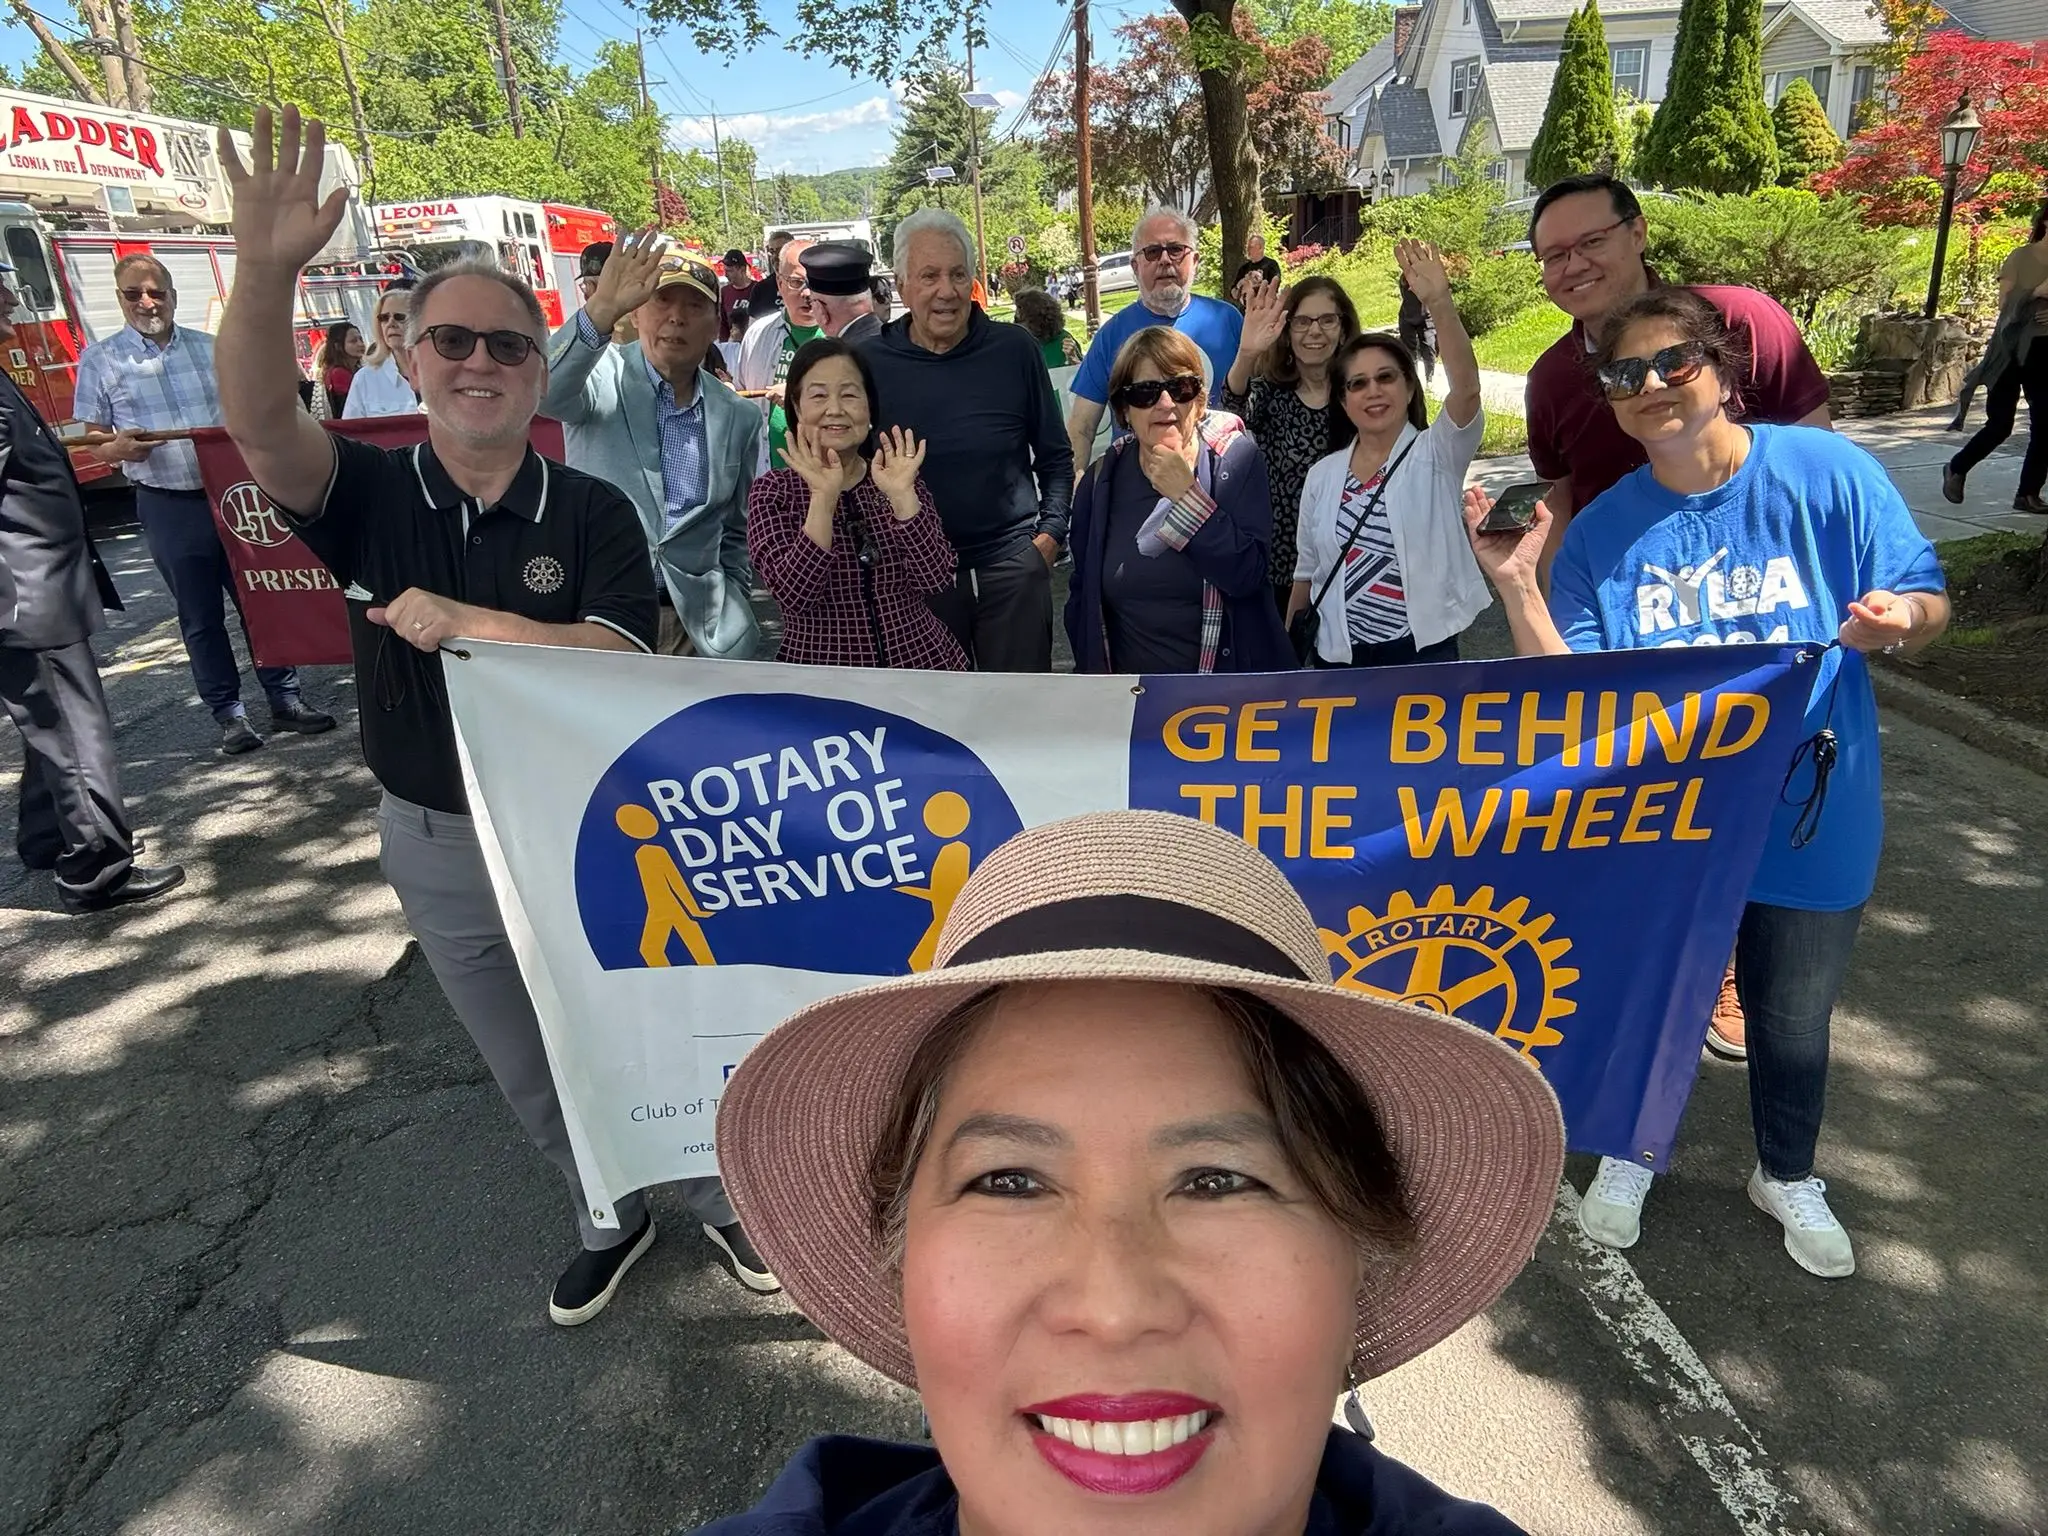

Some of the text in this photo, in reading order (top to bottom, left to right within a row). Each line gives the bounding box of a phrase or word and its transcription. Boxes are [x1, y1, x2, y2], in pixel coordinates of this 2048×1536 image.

[0, 105, 164, 178] ADDER
[8, 154, 147, 181] LEONIA FIRE DEPARTMENT
[380, 203, 459, 221] LEONIA
[1636, 547, 1810, 635] RYLA
[1162, 691, 1771, 767] GET BEHIND
[647, 727, 886, 822] ROTARY
[670, 778, 907, 868] DAY OF
[1179, 777, 1713, 859] THE WHEEL
[692, 834, 925, 911] SERVICE
[1364, 915, 1503, 950] ROTARY
[631, 1102, 677, 1122] Club
[684, 1098, 704, 1115] of
